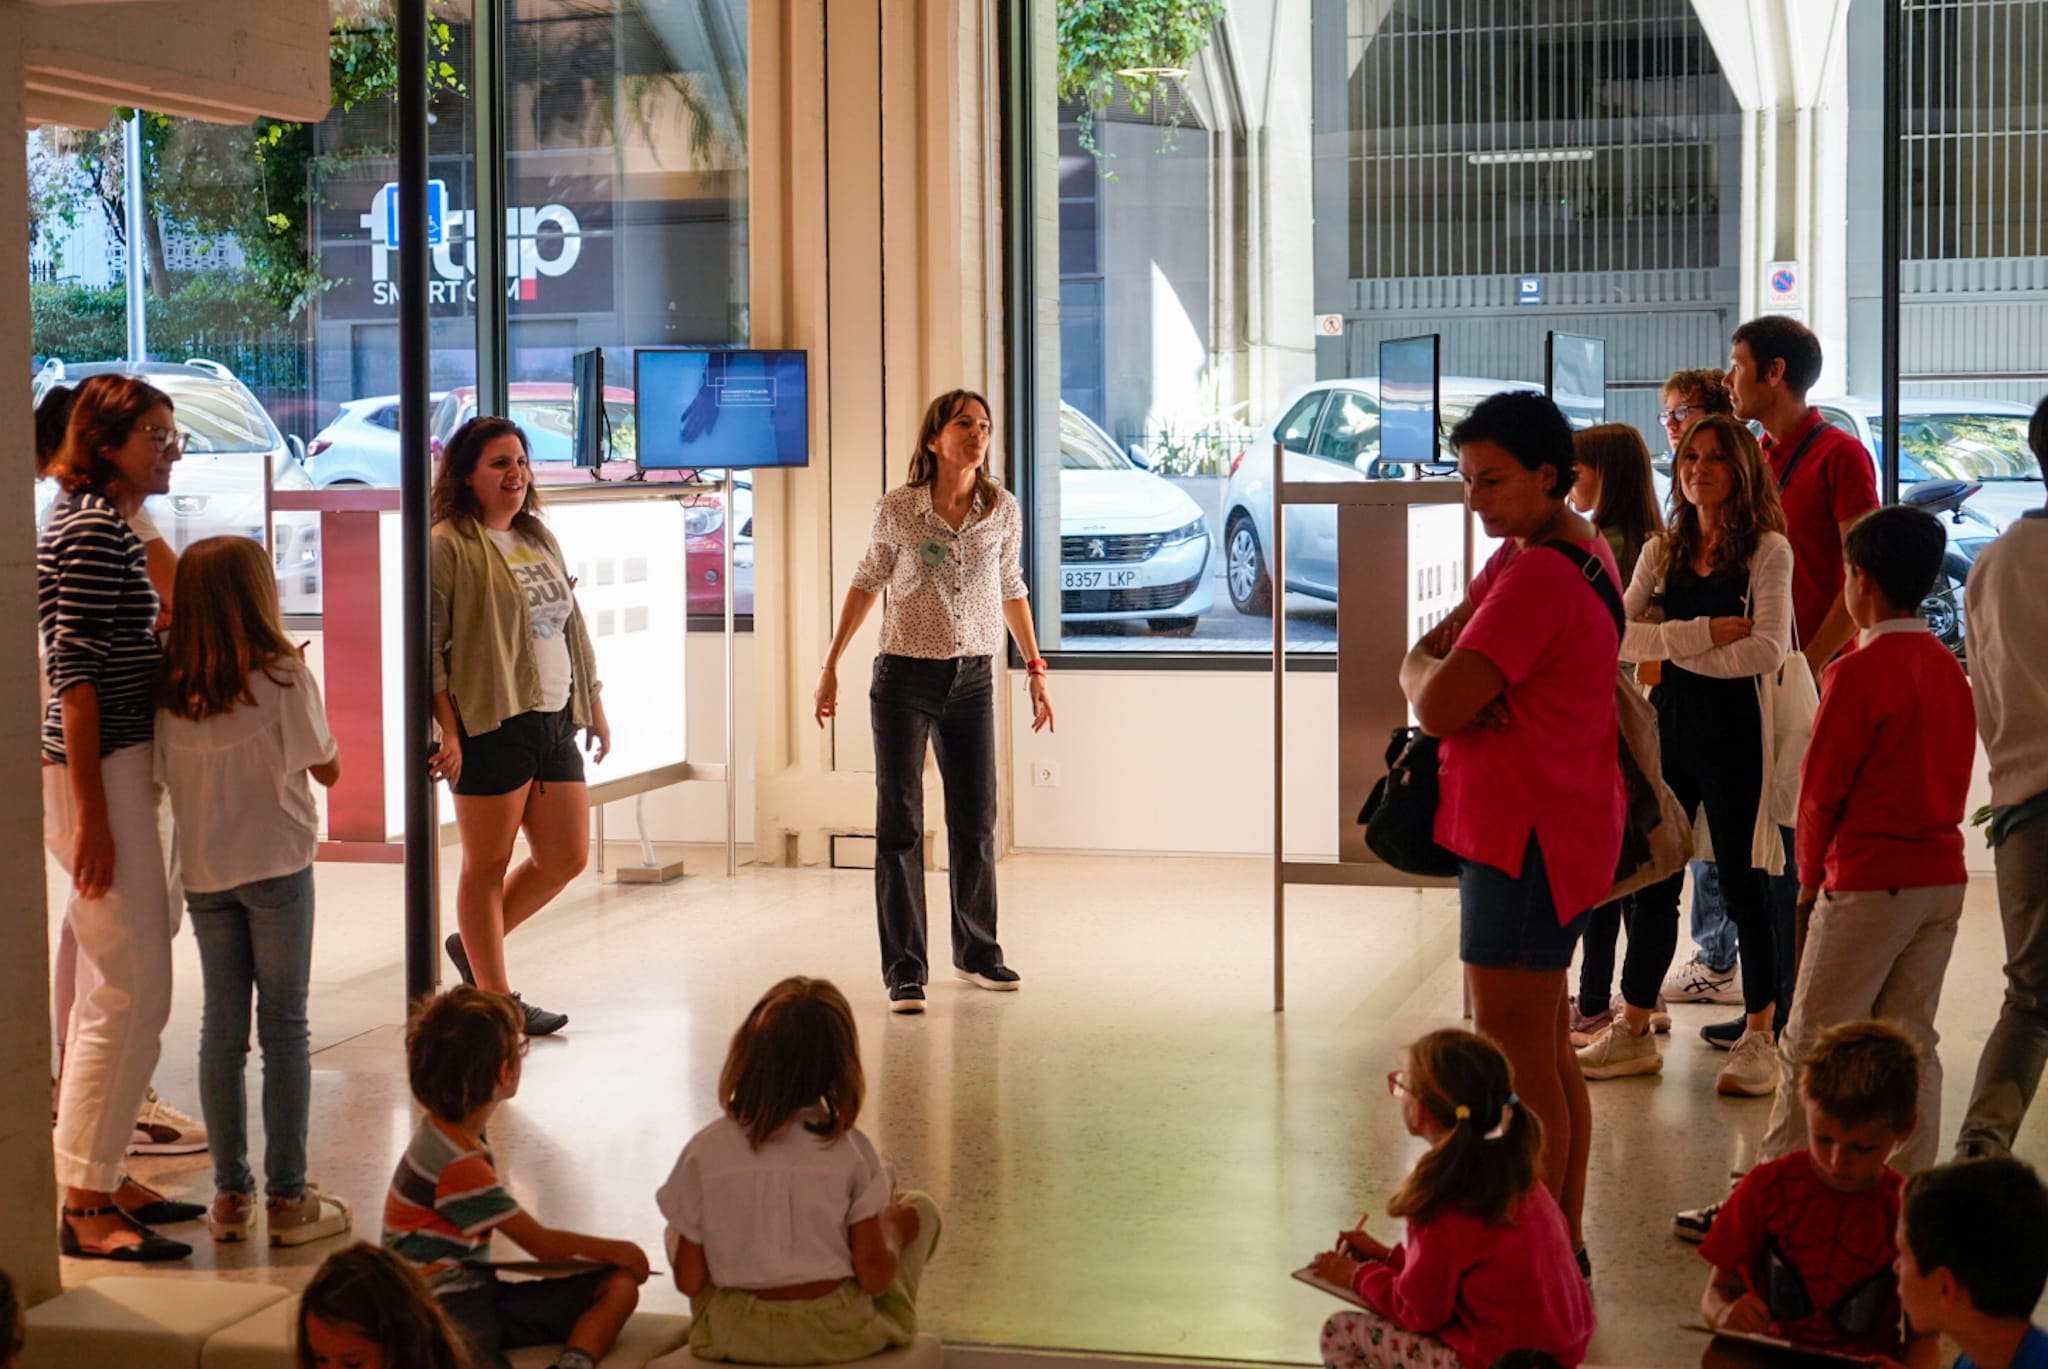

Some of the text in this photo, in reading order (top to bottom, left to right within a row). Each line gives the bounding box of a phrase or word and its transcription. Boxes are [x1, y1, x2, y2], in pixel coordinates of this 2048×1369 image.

[372, 280, 462, 305] SMRT
[511, 562, 557, 585] CHI
[1065, 571, 1135, 588] 8357 LKP
[525, 581, 568, 607] QUI
